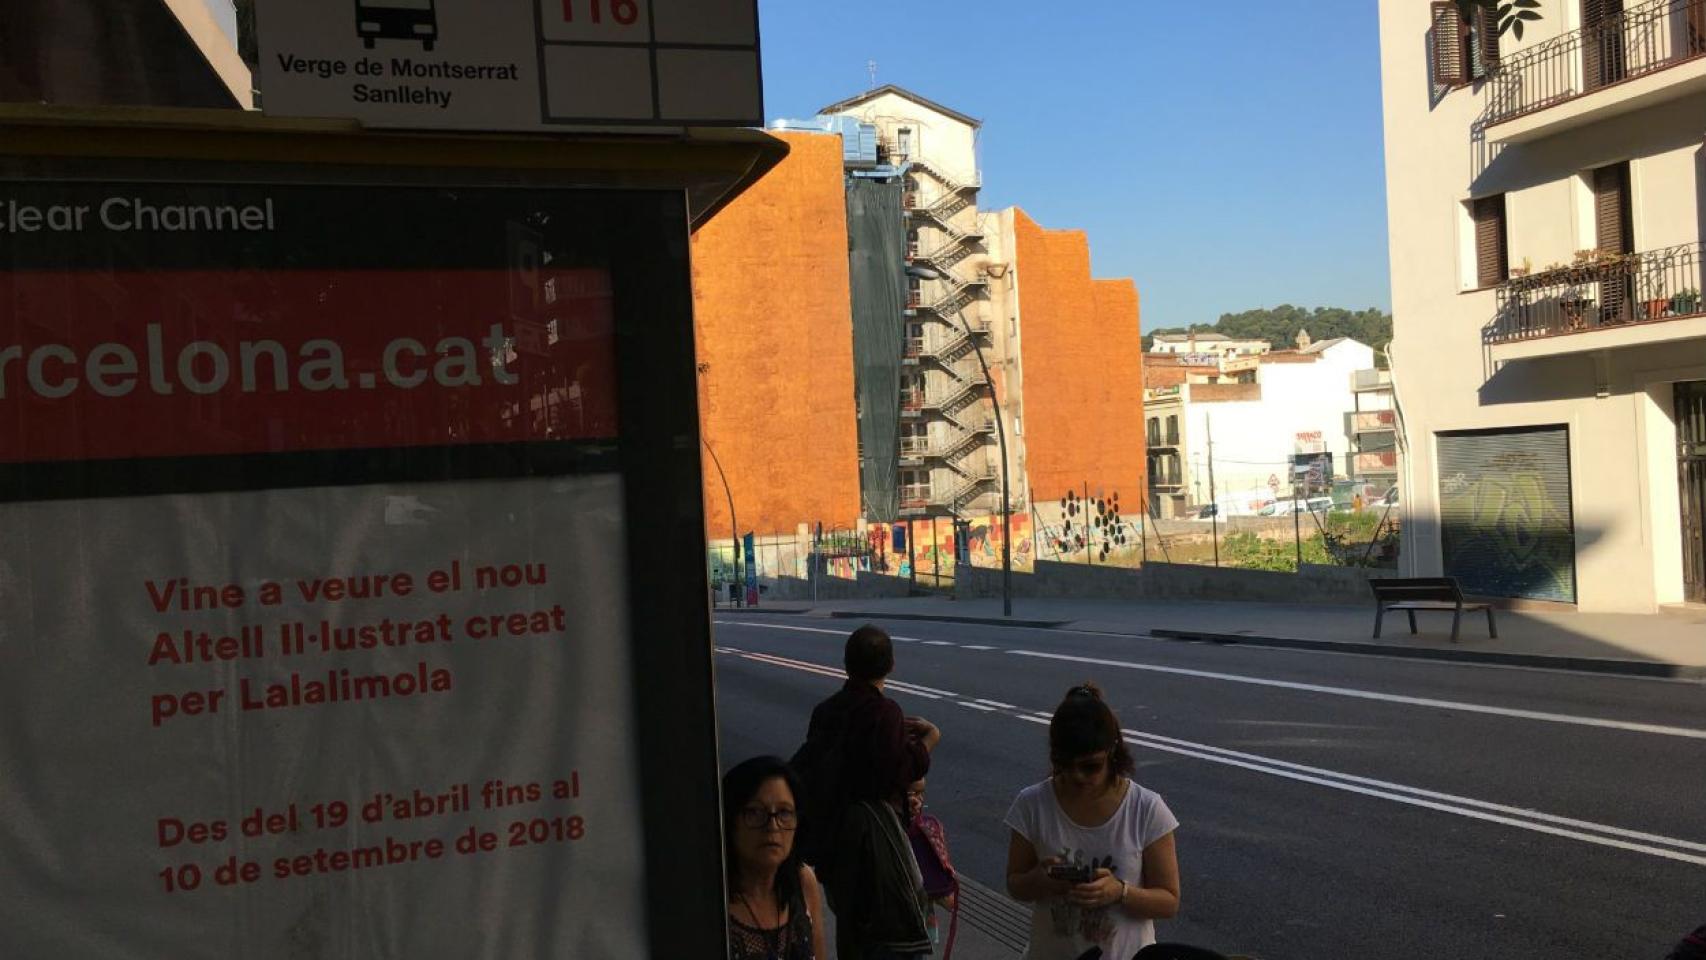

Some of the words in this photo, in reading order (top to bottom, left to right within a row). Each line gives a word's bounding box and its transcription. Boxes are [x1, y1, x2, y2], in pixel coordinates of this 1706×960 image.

[277, 53, 346, 79] Verge
[354, 57, 384, 76] de
[391, 58, 519, 81] Montserrat
[352, 84, 452, 109] Sanllehy
[0, 200, 90, 233] lear
[99, 197, 275, 232] Channel
[145, 577, 245, 613] Vine
[260, 582, 283, 606] a
[298, 572, 413, 603] veure
[426, 560, 462, 592] el
[475, 562, 548, 589] nou
[148, 625, 264, 665] Altell
[464, 604, 567, 640] creat
[151, 690, 224, 727] per
[239, 661, 453, 712] Lalalimola
[157, 816, 228, 848] Des
[240, 804, 298, 838] del
[310, 799, 349, 829] 19
[480, 780, 542, 810] fins
[552, 771, 580, 799] al
[159, 863, 202, 893] 10
[213, 856, 262, 887] de
[272, 836, 445, 879] setembre
[455, 825, 498, 856] de
[508, 814, 586, 848] 2018
